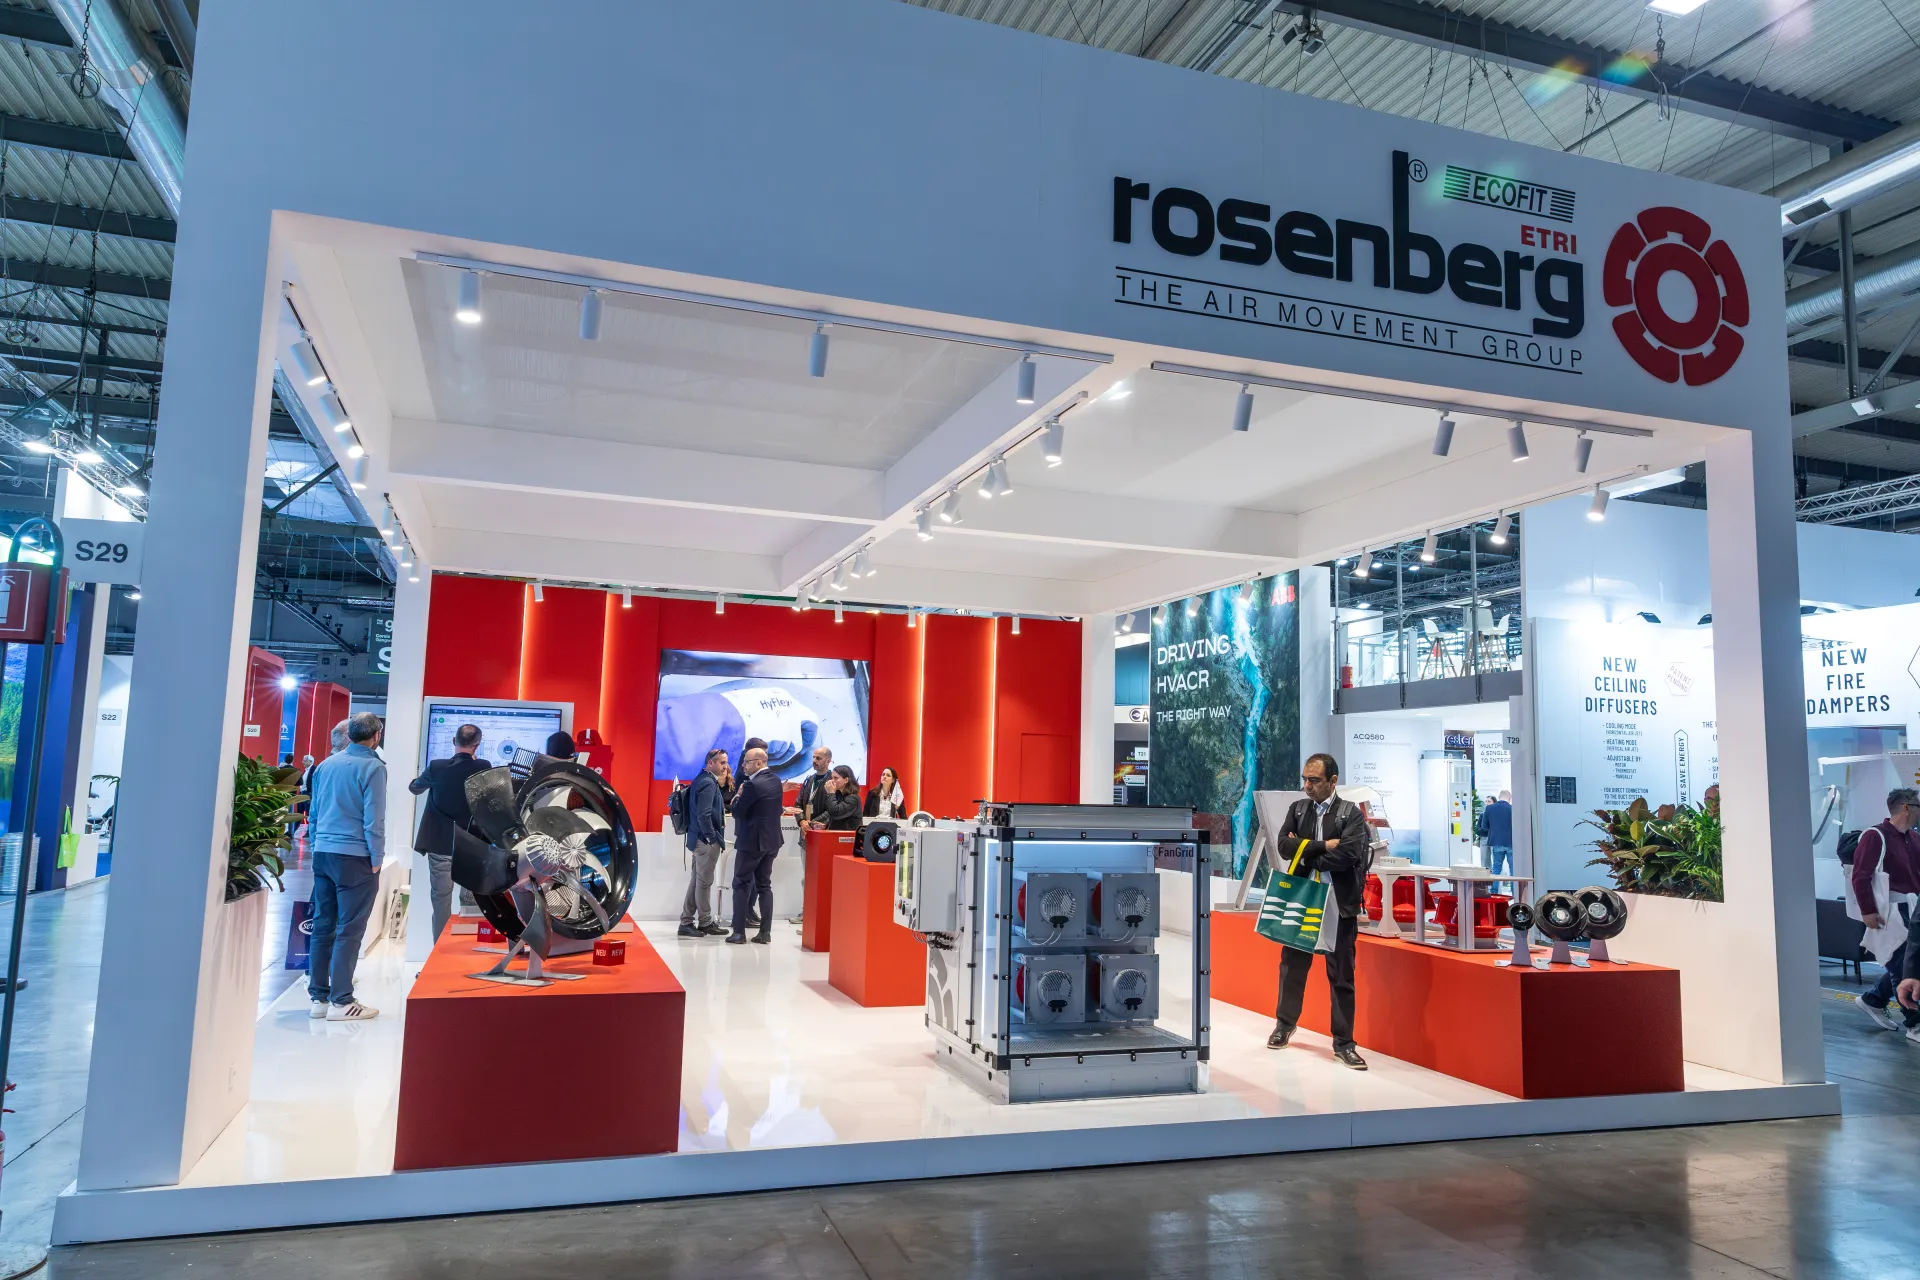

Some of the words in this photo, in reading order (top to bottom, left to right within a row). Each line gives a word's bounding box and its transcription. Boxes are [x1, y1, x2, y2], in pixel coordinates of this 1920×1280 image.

[1472, 176, 1548, 212] ECOFIT
[1113, 150, 1585, 339] rosenberg
[1520, 224, 1577, 254] ETRI
[1116, 274, 1182, 306] THE
[1204, 290, 1258, 318] AIR
[1278, 301, 1458, 349] MOVEMENT
[1482, 335, 1582, 368] GROUP
[74, 540, 129, 564] S29
[1272, 585, 1296, 606] ABB
[1157, 634, 1232, 666] DRIVING
[1822, 648, 1868, 667] NEW
[1603, 656, 1636, 672] NEW
[1156, 670, 1210, 694] HVACR
[1670, 666, 1692, 684] PATENT
[1826, 672, 1866, 690] FIRE
[1594, 676, 1647, 694] CEILING
[1156, 710, 1174, 722] THE
[1176, 707, 1206, 721] RIGHT
[1208, 704, 1232, 718] WAY
[1585, 696, 1657, 715] DIFFUSERS
[1806, 694, 1890, 714] DAMPERS
[1702, 720, 1714, 728] THE
[1680, 790, 1687, 802] WE
